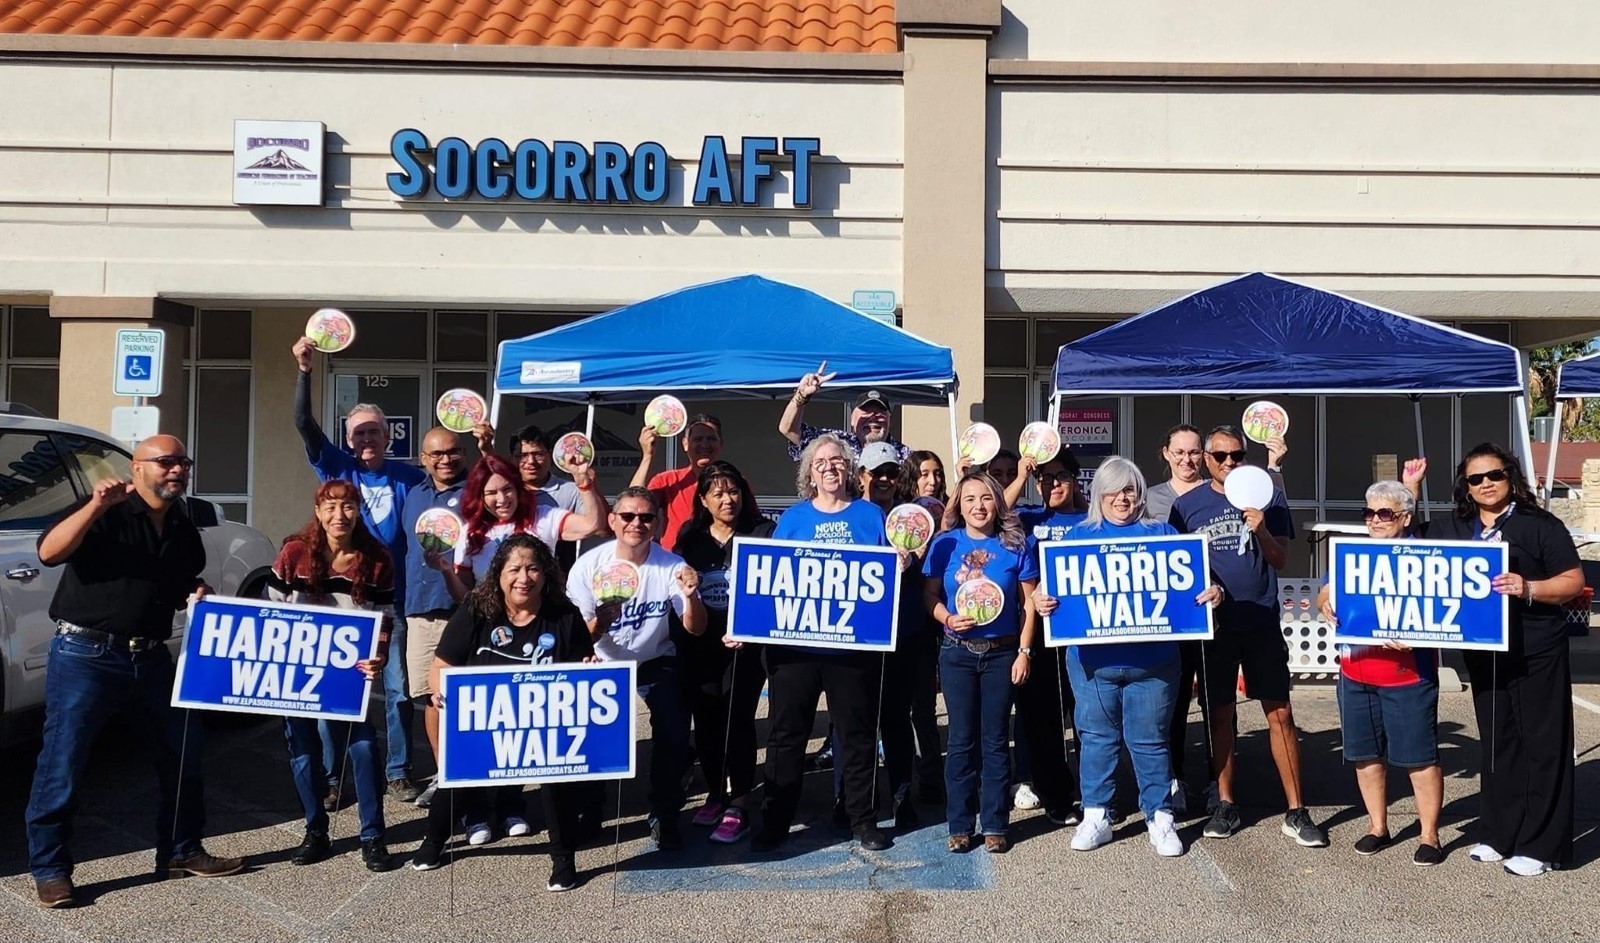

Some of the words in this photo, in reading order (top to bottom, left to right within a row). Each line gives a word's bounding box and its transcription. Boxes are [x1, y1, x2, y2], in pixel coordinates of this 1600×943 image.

[386, 128, 669, 203] SOCORRO
[692, 135, 821, 207] AFT
[122, 335, 158, 343] RESERVED
[364, 375, 389, 387] 125
[794, 549, 803, 557] El
[1100, 545, 1109, 553] El
[1391, 546, 1401, 554] El
[746, 554, 885, 603] HARRIS
[1055, 550, 1195, 597] HARRIS
[1344, 553, 1491, 600] HARRIS
[259, 609, 270, 618] El
[775, 597, 855, 634] WALZ
[1086, 591, 1169, 628] WALZ
[1374, 596, 1461, 633] WALZ
[770, 630, 856, 642] WWW.ELPASODEMOCRATS.COM
[1086, 625, 1172, 638] WWW.ELPASODEMOCRATS.COM
[1372, 629, 1464, 642] WWW.ELPASODEMOCRATS.COM
[199, 613, 360, 669] HARRIS
[231, 660, 325, 702] WALZ
[512, 673, 523, 682] El
[222, 696, 321, 711] WWW.ELPASODEMOCRATS.COM
[458, 679, 619, 731] HARRIS
[492, 727, 587, 768] WALZ
[489, 765, 589, 778] WWW.ELPASODEMOCRATS.COM
